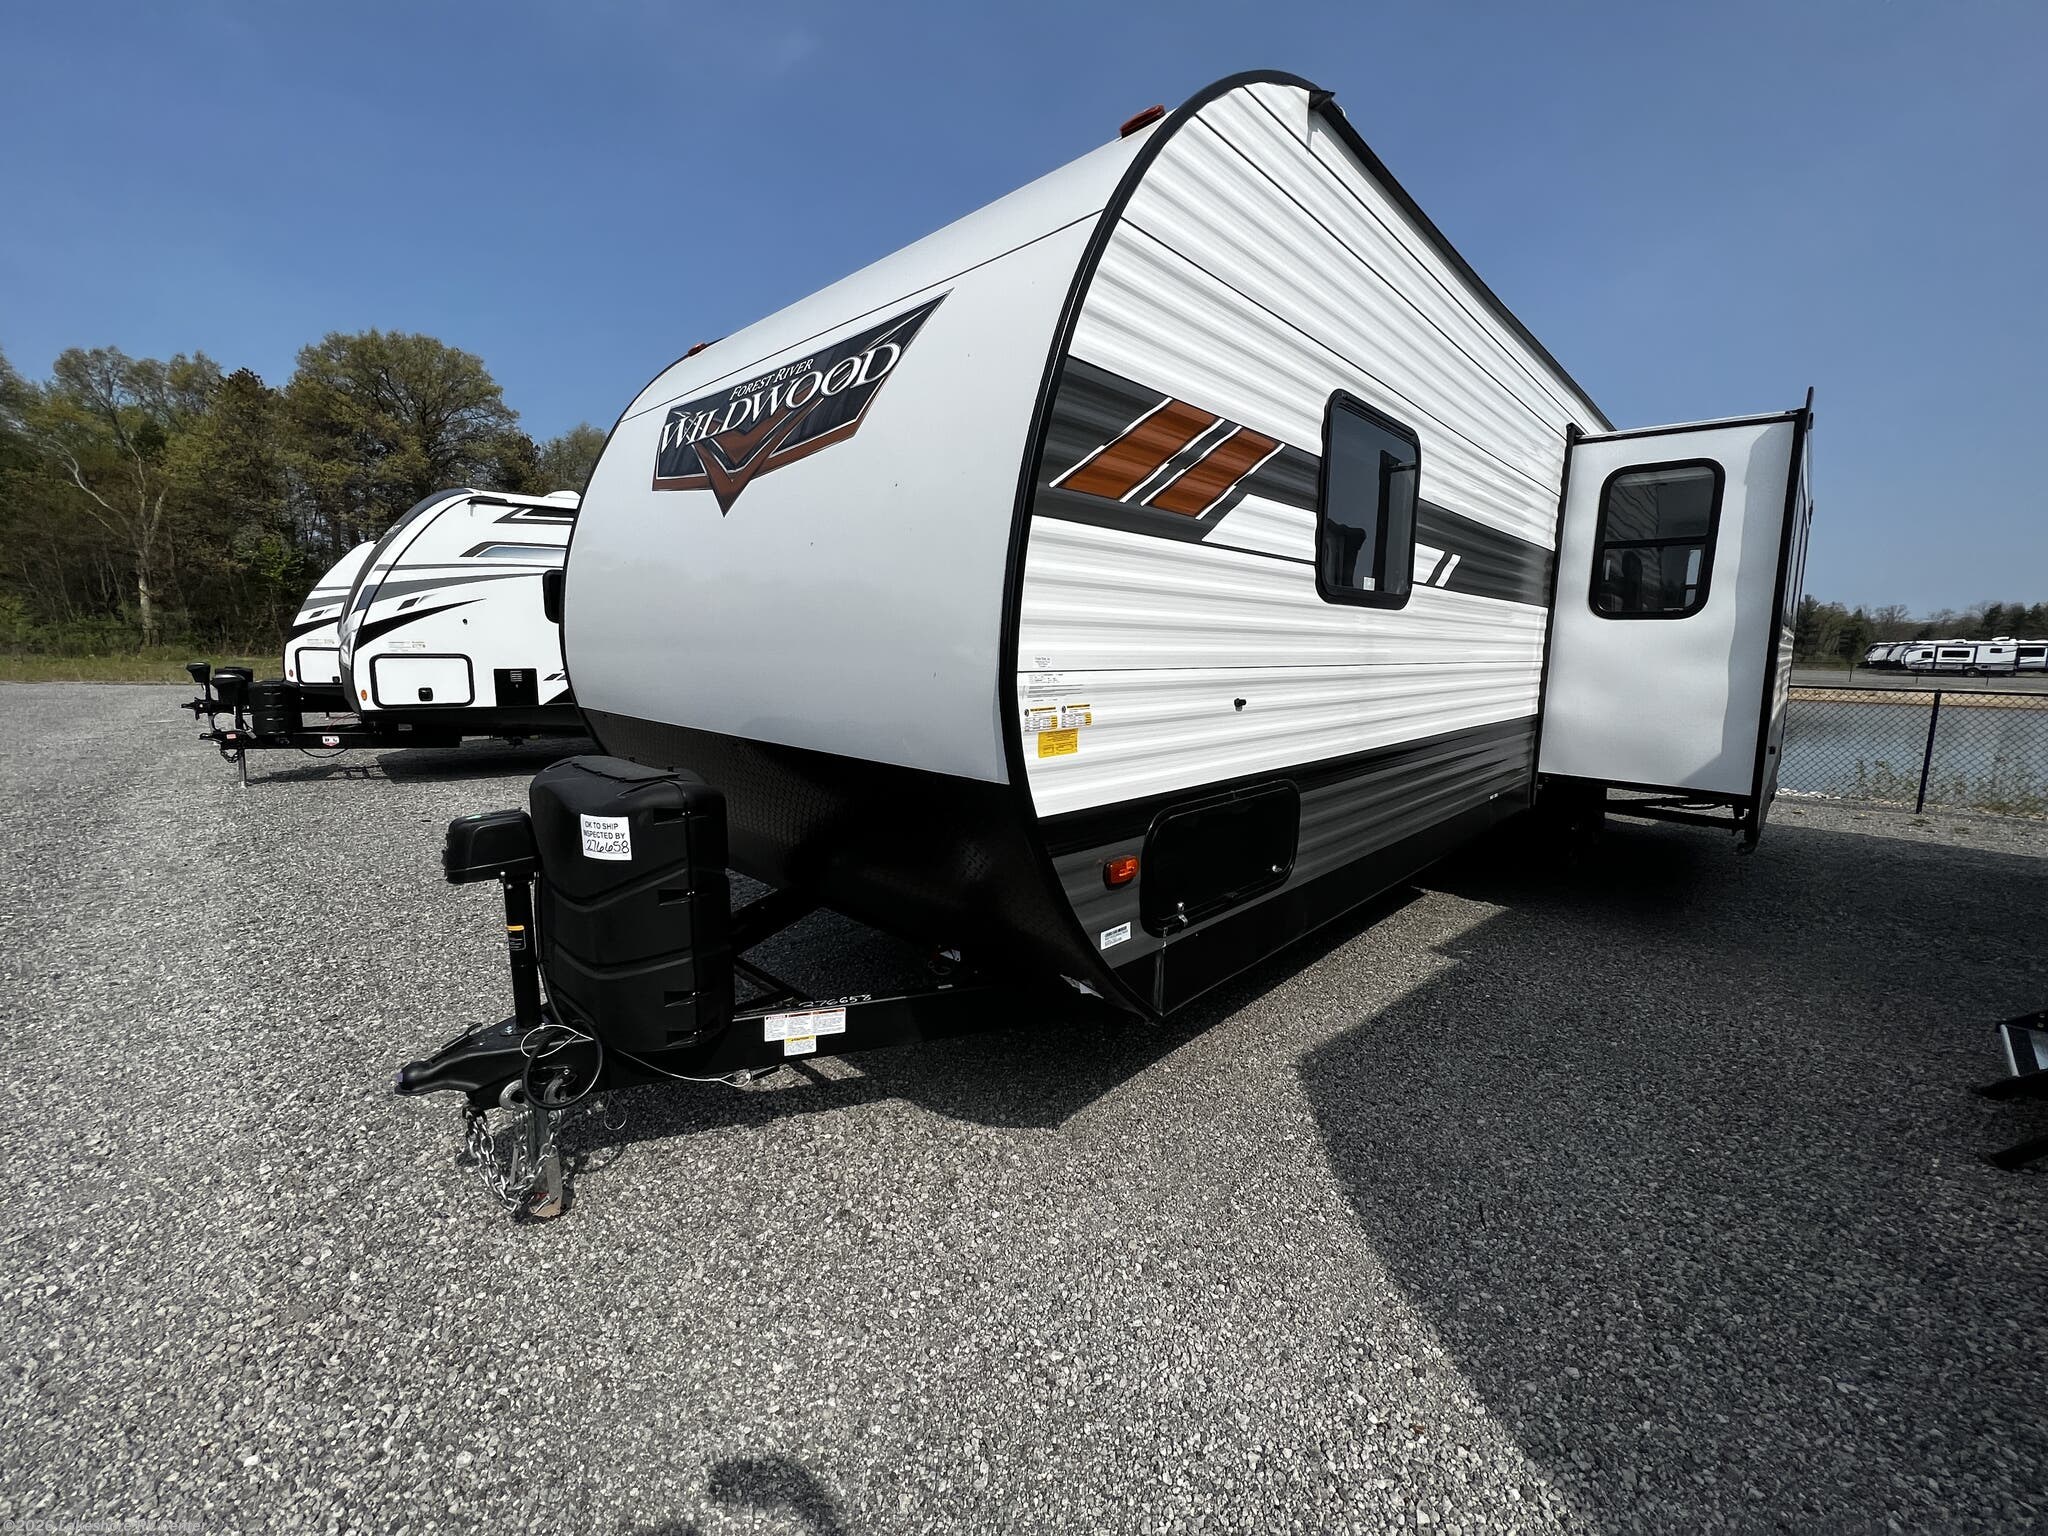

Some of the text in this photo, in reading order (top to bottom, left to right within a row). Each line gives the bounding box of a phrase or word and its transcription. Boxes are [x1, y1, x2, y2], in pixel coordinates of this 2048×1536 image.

[729, 358, 814, 400] FOREST RIVER
[661, 342, 901, 453] WILDWOOD
[593, 821, 601, 830] TO
[602, 822, 619, 830] SHIP
[585, 839, 630, 854] 276658
